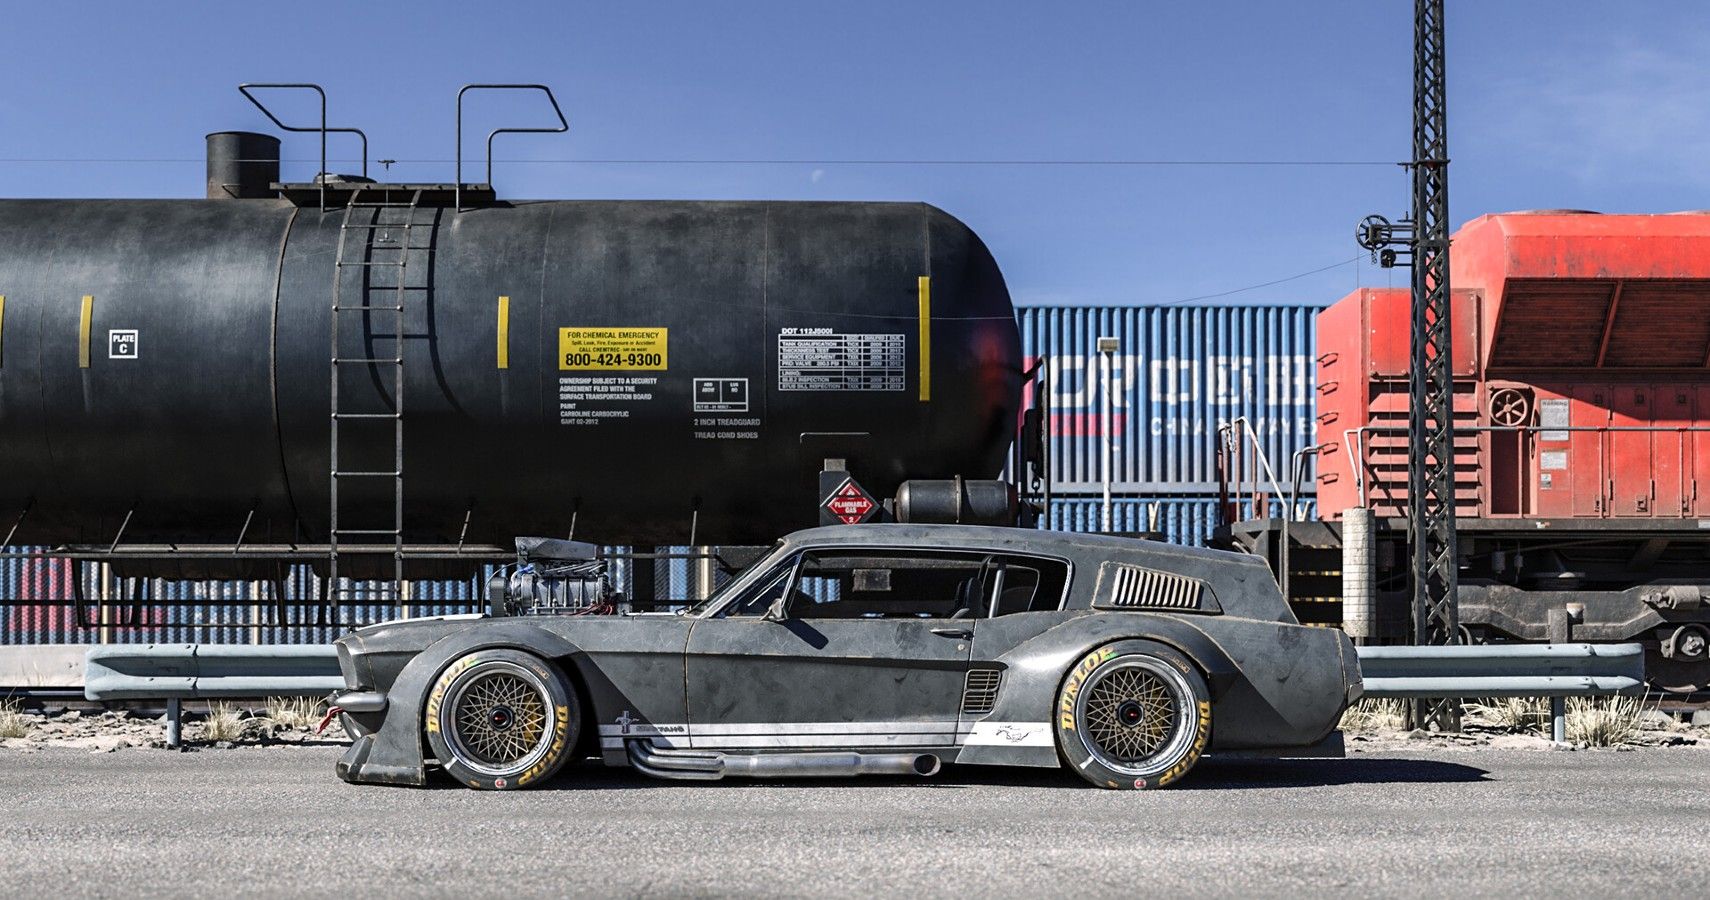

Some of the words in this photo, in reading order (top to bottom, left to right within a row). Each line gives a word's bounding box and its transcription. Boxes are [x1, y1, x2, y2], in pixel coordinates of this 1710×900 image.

[112, 334, 135, 343] PLATE
[119, 343, 128, 354] C
[565, 353, 661, 366] 800-424-9300
[1061, 646, 1116, 732] DUNLOP
